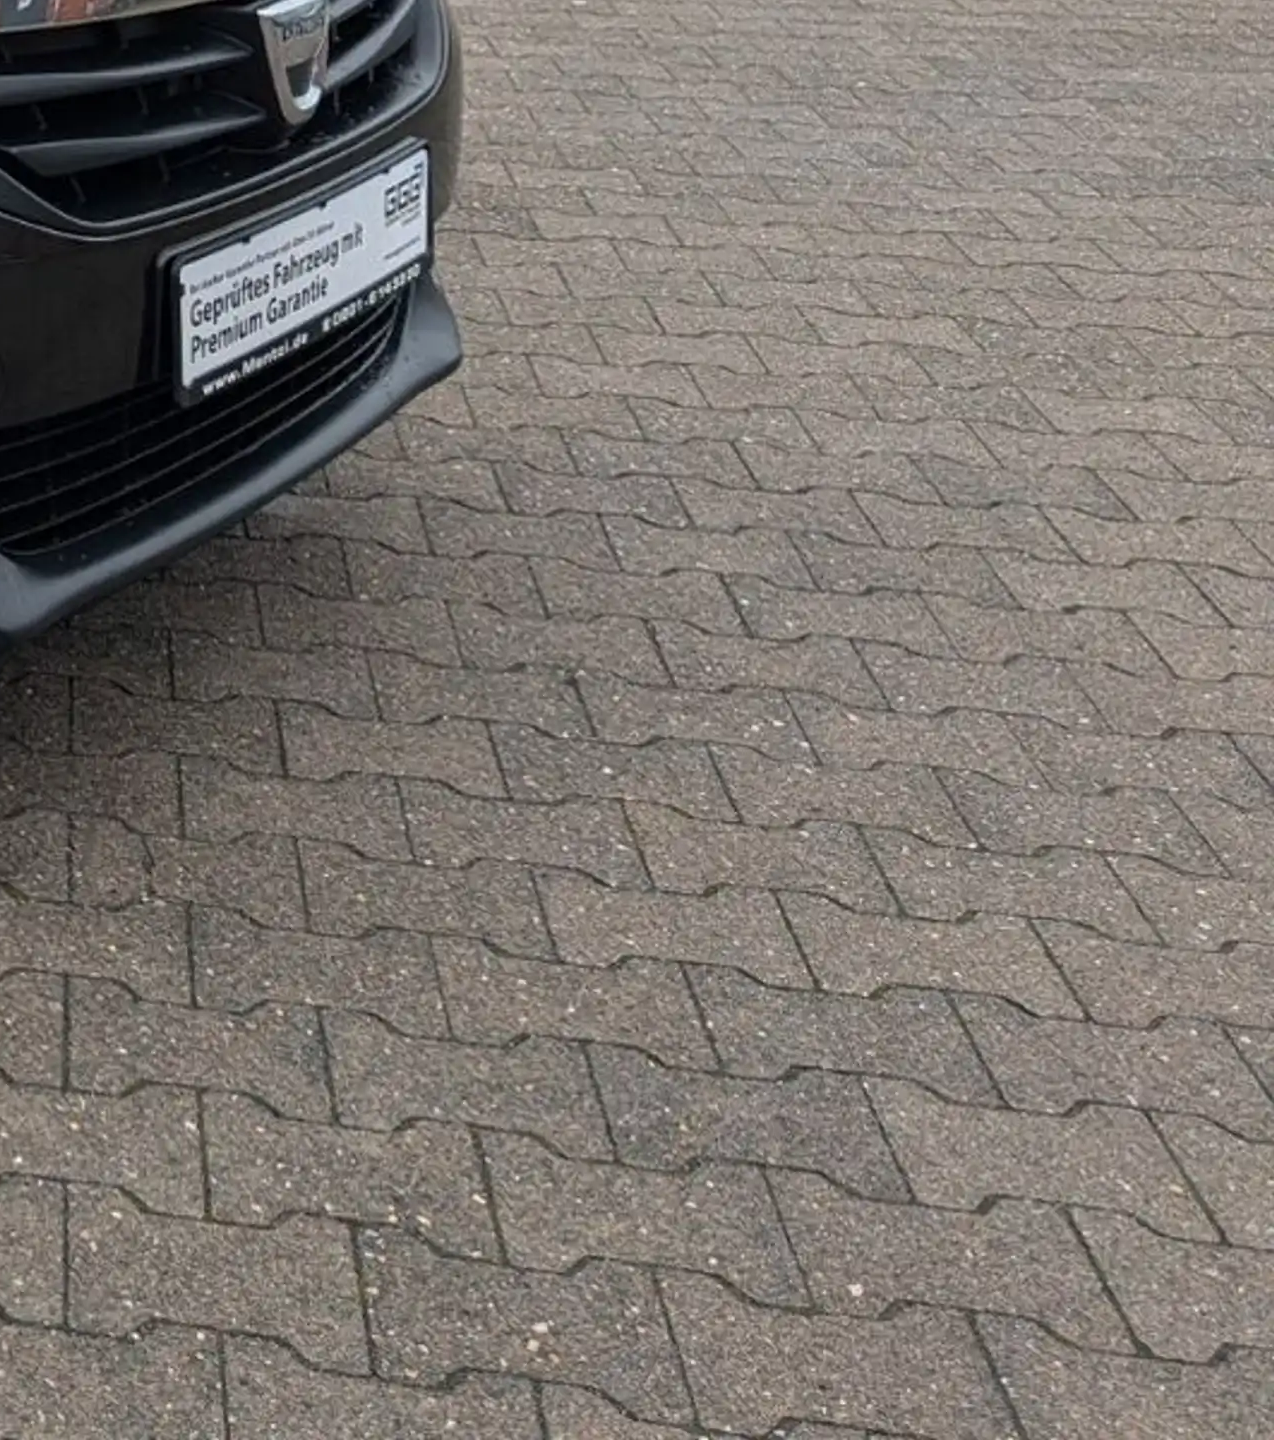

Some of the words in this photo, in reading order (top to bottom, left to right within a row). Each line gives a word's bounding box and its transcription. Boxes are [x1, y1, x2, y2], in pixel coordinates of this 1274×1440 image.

[189, 271, 270, 328] Geprüftes
[272, 235, 339, 288] Fahrzeug
[341, 222, 364, 254] mit
[191, 313, 263, 364] Premium
[266, 274, 329, 324] Garantie
